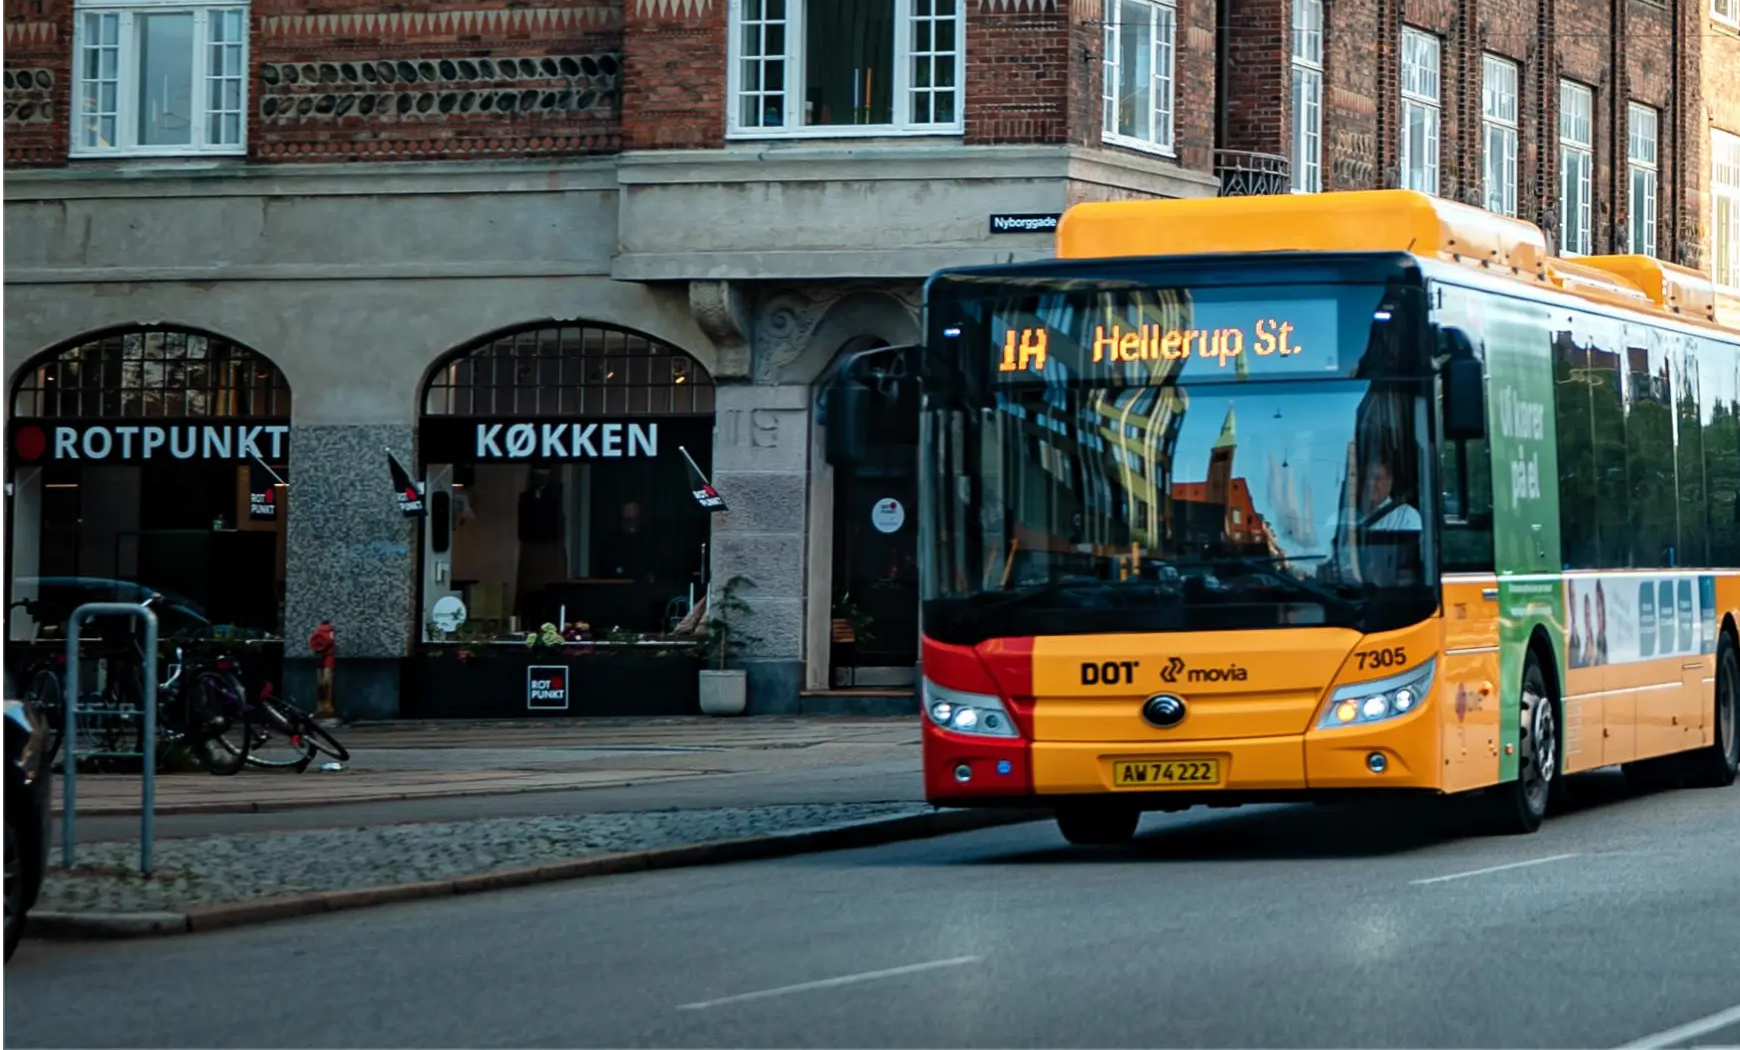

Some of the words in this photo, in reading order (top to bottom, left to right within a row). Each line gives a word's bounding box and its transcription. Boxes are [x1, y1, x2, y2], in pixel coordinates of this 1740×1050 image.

[994, 216, 1057, 230] Nyborggade
[1093, 323, 1244, 367] Hellerup
[1253, 318, 1302, 358] St.
[54, 425, 289, 459] ROTPUNKT
[476, 422, 659, 458] KØKKEN
[1354, 647, 1407, 670] 7305
[1080, 661, 1139, 685] DOT
[1187, 664, 1248, 683] movia
[531, 680, 551, 689] ROT
[531, 689, 564, 699] PUNKT
[1122, 765, 1147, 782] AW
[1151, 763, 1177, 782] 74
[1179, 762, 1211, 781] 222
